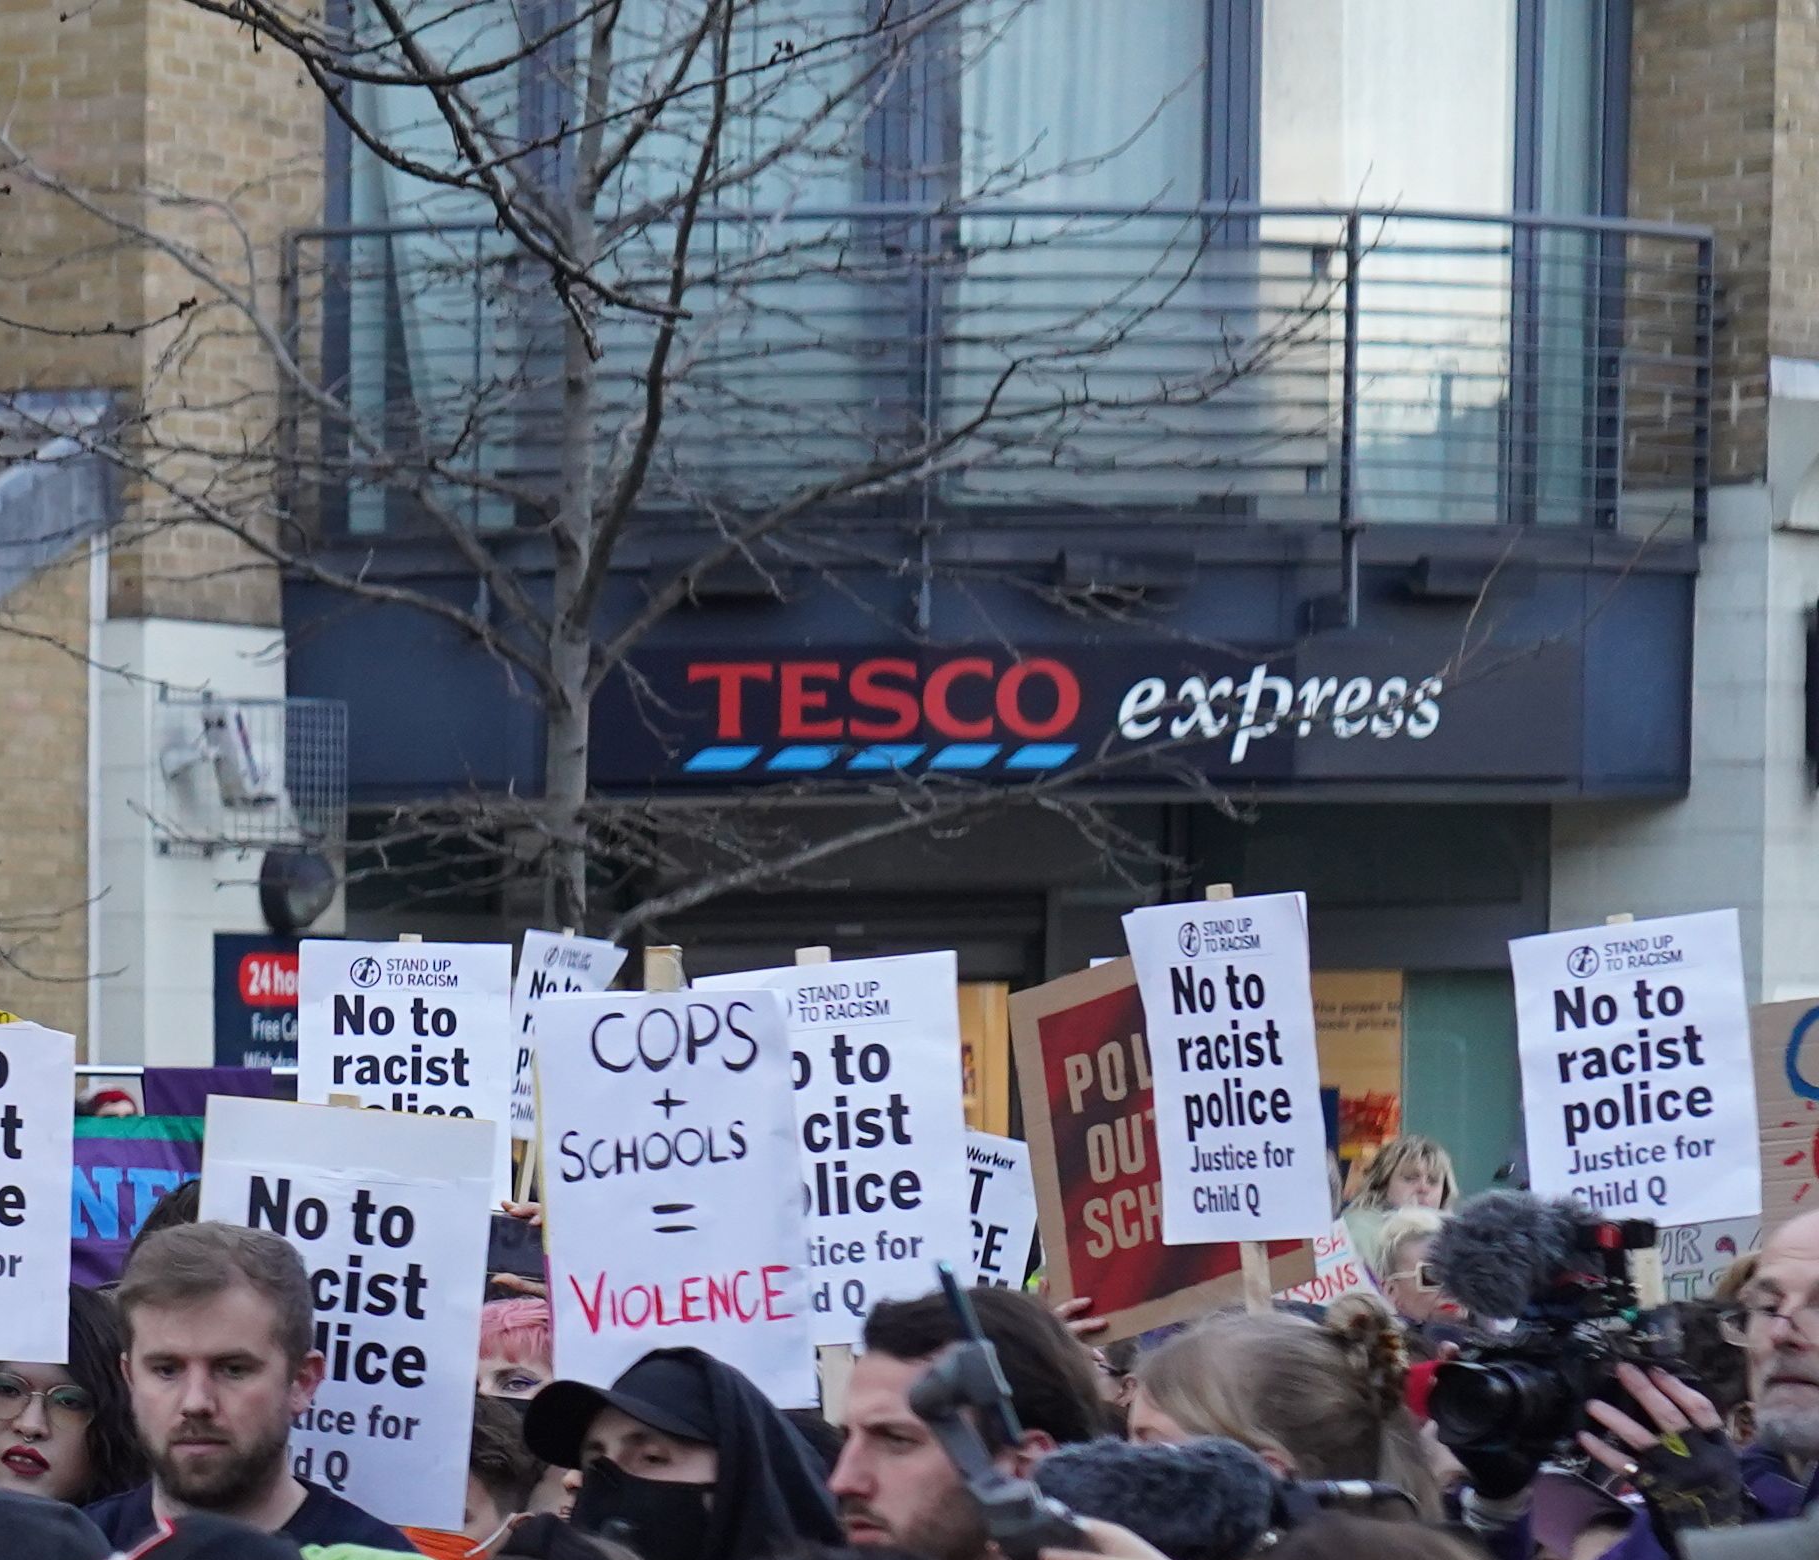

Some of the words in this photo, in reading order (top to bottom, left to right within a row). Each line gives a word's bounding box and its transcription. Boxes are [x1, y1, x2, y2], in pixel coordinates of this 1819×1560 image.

[688, 657, 1081, 740] TESCO
[1118, 664, 1444, 764] express
[1203, 920, 1234, 936] STAND
[1237, 918, 1252, 933] UP
[1204, 939, 1218, 952] TO
[1220, 934, 1260, 951] RACISM
[1604, 939, 1648, 956] STAND
[1653, 935, 1673, 949] UP
[249, 960, 270, 996] 24
[387, 959, 428, 971] STAND
[433, 960, 451, 972] UP
[387, 973, 403, 985] TO
[408, 974, 457, 986] RACISM
[1605, 958, 1623, 971] TO
[1628, 950, 1683, 968] RACISM
[798, 983, 849, 1005] STAND
[854, 980, 881, 998] UP
[1170, 966, 1215, 1015] No
[1226, 965, 1264, 1010] to
[1554, 986, 1617, 1031] No
[1634, 980, 1683, 1019] to
[252, 1012, 280, 1041] Free
[334, 995, 394, 1035] No
[411, 998, 456, 1037] to
[799, 1007, 819, 1022] TO
[825, 1000, 889, 1020] RACISM
[592, 1002, 758, 1073] COPS
[1178, 1020, 1282, 1072] racist
[1558, 1025, 1704, 1083] racist
[334, 1044, 469, 1086] racist
[831, 1035, 890, 1085] to
[803, 1094, 911, 1153] cist
[1185, 1078, 1291, 1142] police
[1564, 1081, 1712, 1147] police
[561, 1120, 748, 1184] SCHOOLS
[1190, 1144, 1257, 1172] Justice
[1264, 1141, 1294, 1168] for
[1569, 1142, 1665, 1174] Justice
[1675, 1135, 1715, 1159] for
[1194, 1185, 1240, 1213] Child
[1246, 1184, 1260, 1217] Q
[1648, 1176, 1666, 1206] Q
[248, 1176, 328, 1240] No
[352, 1190, 414, 1248] to
[876, 1230, 923, 1260] for
[570, 1265, 794, 1333] VIOLENCE
[842, 1280, 867, 1318] Q
[368, 1405, 419, 1440] for
[325, 1451, 348, 1491] Q
